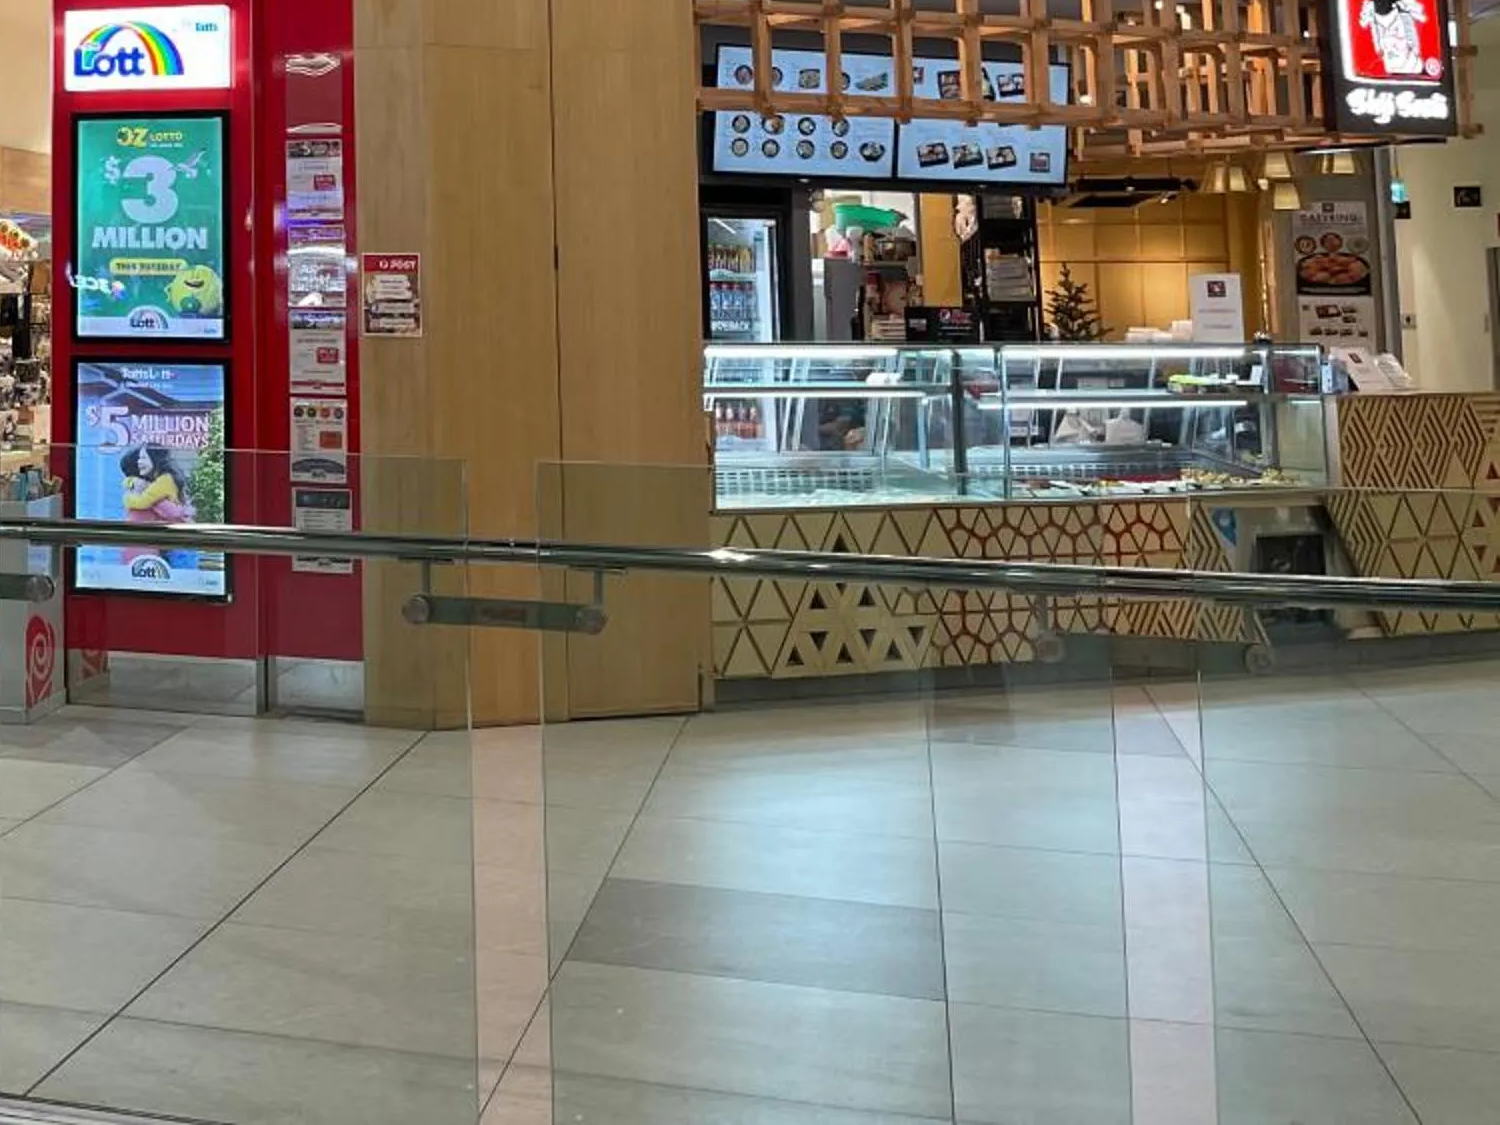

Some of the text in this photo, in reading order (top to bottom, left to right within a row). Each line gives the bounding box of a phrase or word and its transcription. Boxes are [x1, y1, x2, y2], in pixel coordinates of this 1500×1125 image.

[150, 132, 183, 142] LOTTO
[92, 226, 208, 250] MILLION
[390, 259, 416, 270] POST
[131, 413, 209, 432] MILLION
[131, 432, 209, 448] SATURDAYS
